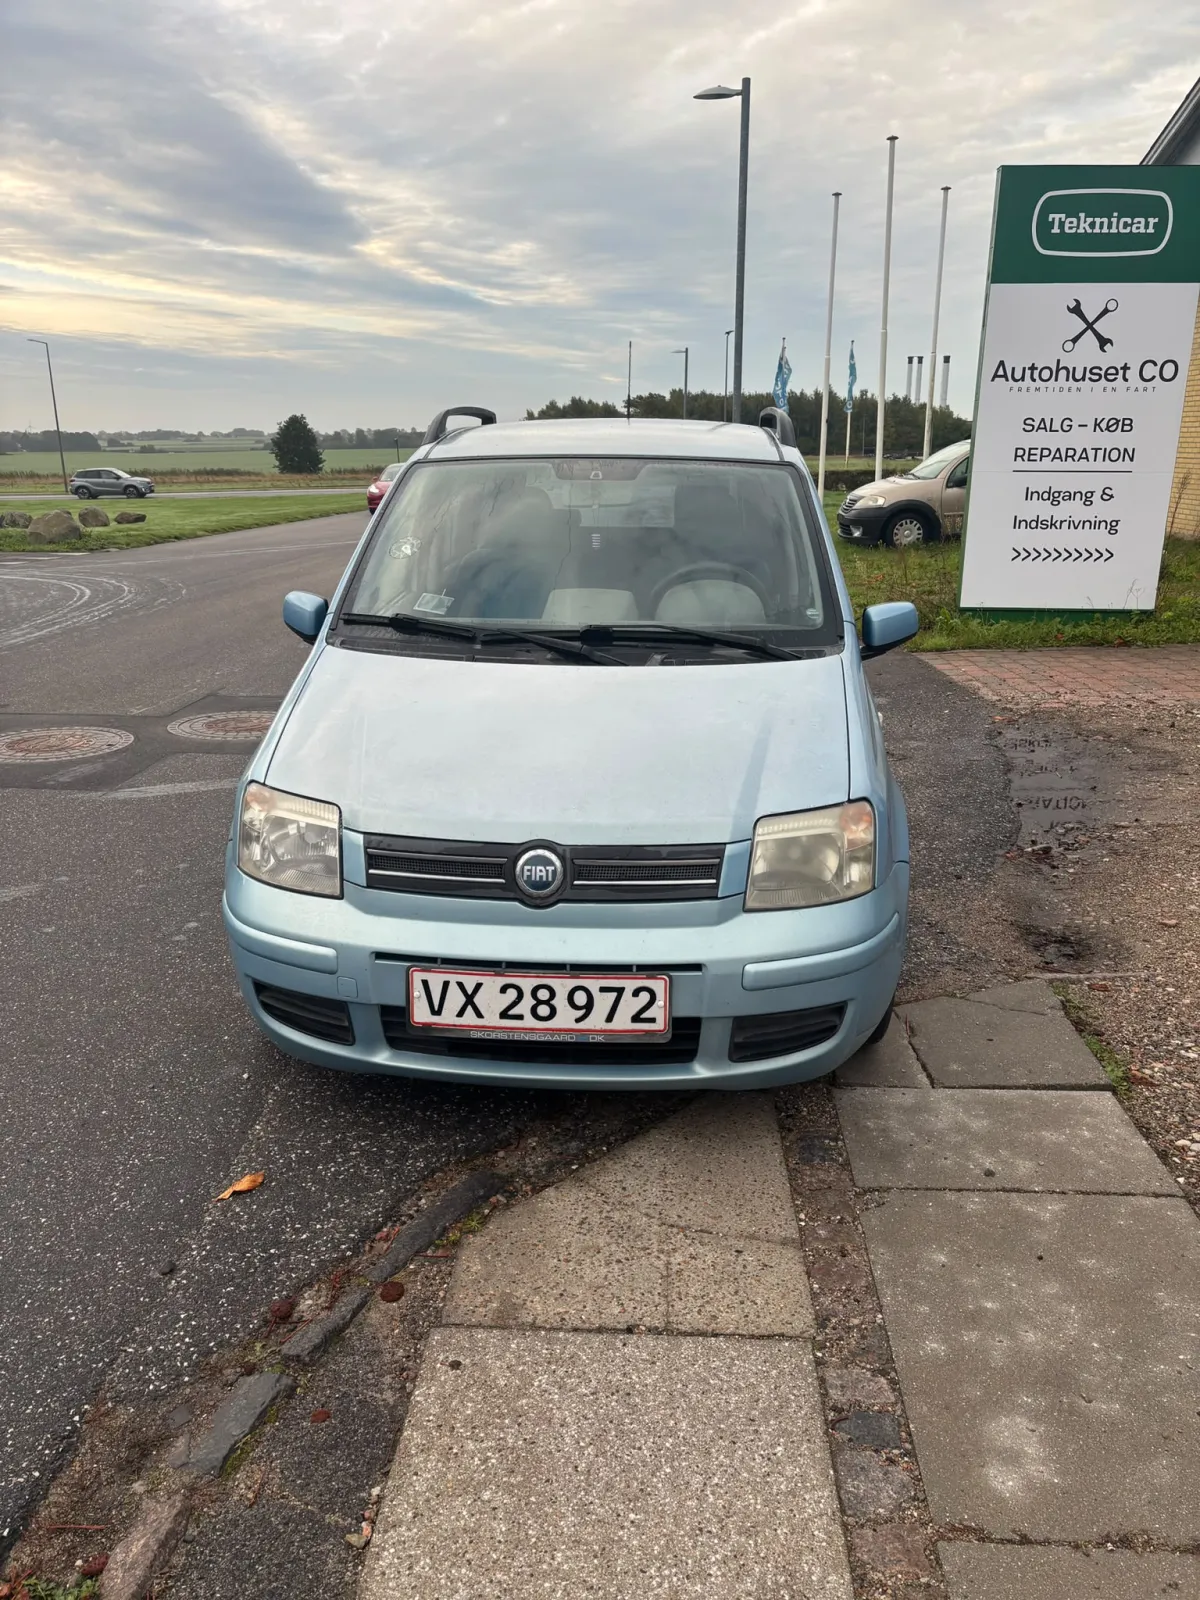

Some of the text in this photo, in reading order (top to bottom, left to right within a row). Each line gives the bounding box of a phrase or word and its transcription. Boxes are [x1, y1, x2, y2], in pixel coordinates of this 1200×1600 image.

[1048, 212, 1159, 234] Teknicar
[990, 358, 1179, 383] Autohuset CO
[1022, 417, 1073, 433] SALG
[1092, 417, 1134, 433] KØB
[1013, 447, 1136, 463] REPARATION
[1024, 486, 1115, 507] Indgang &
[1012, 515, 1121, 536] Indskrivning
[523, 865, 555, 882] FIAT
[469, 1030, 576, 1042] SKORSTENSGAARD
